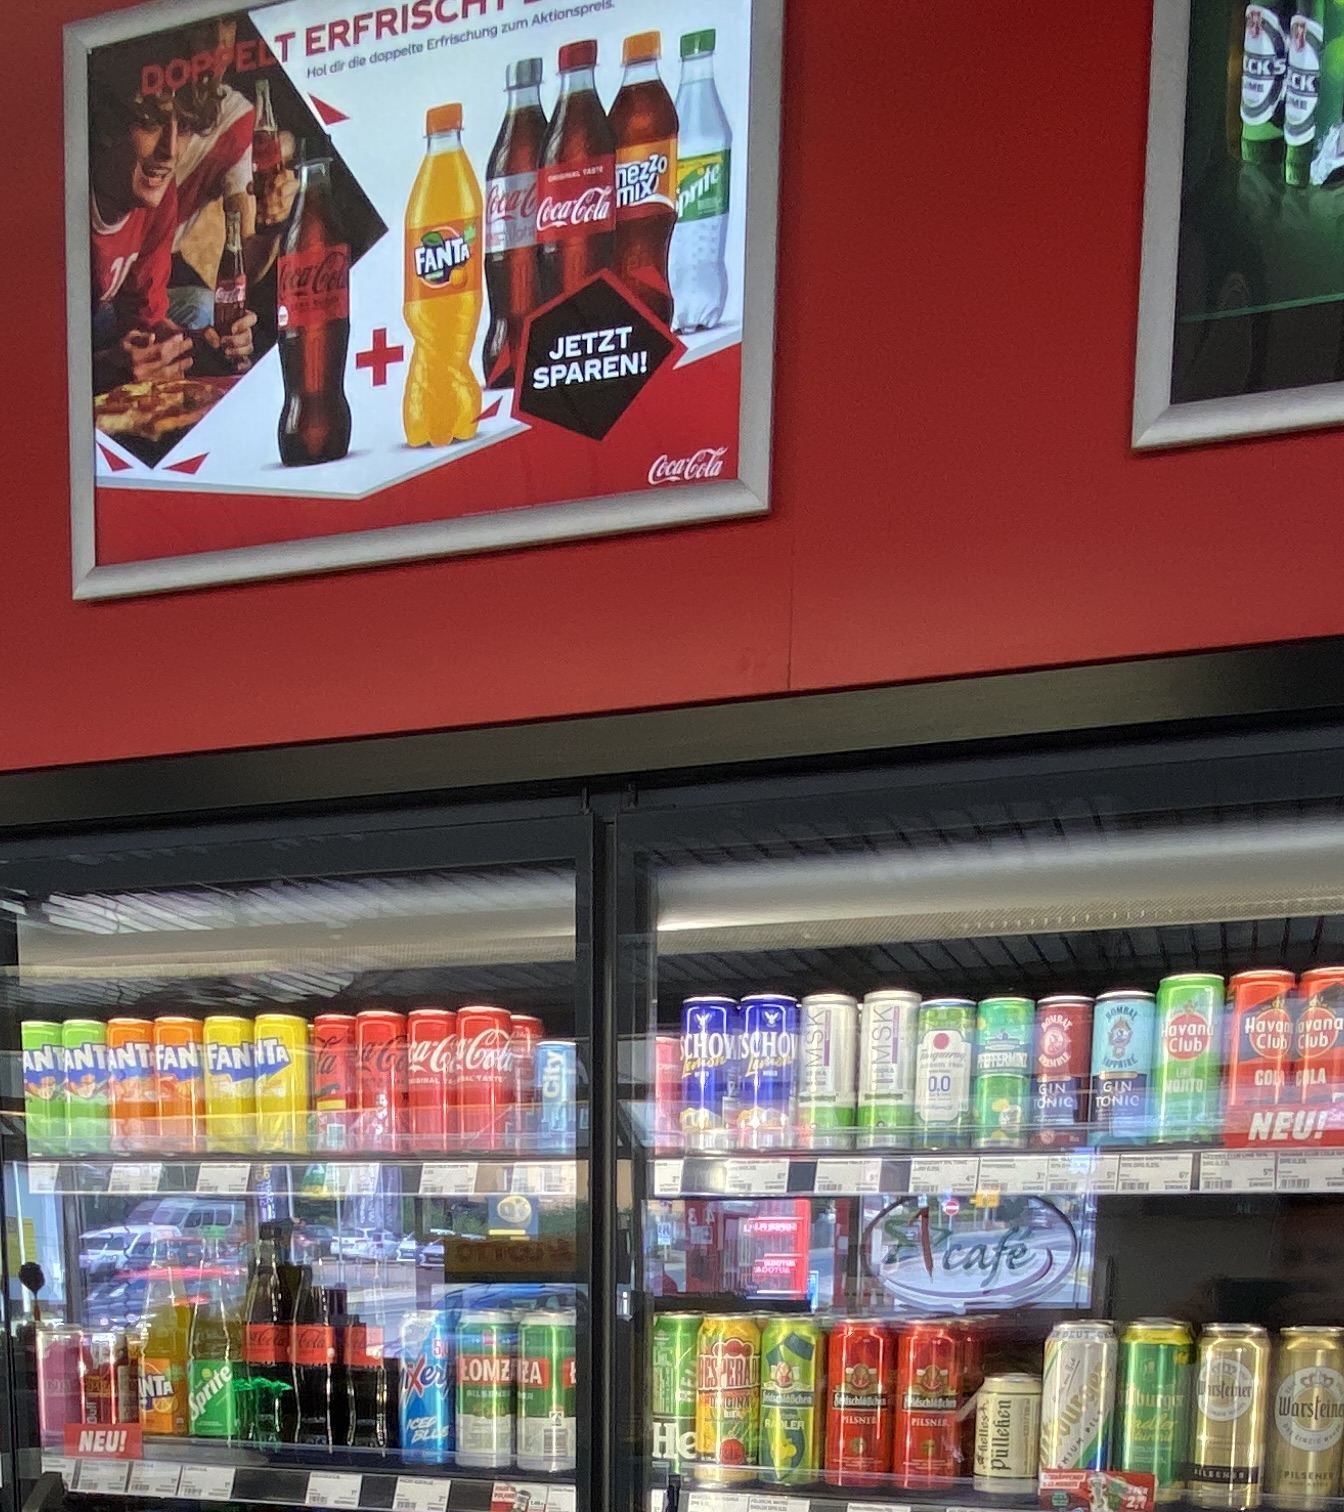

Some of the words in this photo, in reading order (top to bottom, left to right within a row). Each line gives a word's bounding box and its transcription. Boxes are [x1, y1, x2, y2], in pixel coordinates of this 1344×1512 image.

[141, 31, 296, 93] DOPPELT
[307, 64, 327, 79] Hol
[330, 60, 345, 74] dir
[348, 56, 366, 69] die
[369, 44, 423, 66] doppelte
[427, 26, 498, 51] Erfrischung
[502, 19, 528, 34] zum
[537, 186, 612, 231] Coca-Cola
[677, 164, 721, 219] prite
[415, 237, 470, 275] FANTA
[549, 326, 632, 361] JETZT
[533, 351, 648, 390] SPAREN!
[648, 447, 729, 485] Coca-Cola
[1168, 1037, 1203, 1053] Club
[1255, 1034, 1288, 1050] Club
[541, 1050, 562, 1098] City
[1038, 1081, 1066, 1095] GIN
[1102, 1080, 1133, 1094] GIN
[1096, 1094, 1141, 1108] TONIC
[1247, 1111, 1328, 1142] NEU!
[943, 1222, 1037, 1288] café
[189, 1364, 233, 1419] Sprite
[79, 1430, 127, 1453] NEU!
[764, 1419, 805, 1431] RADLER
